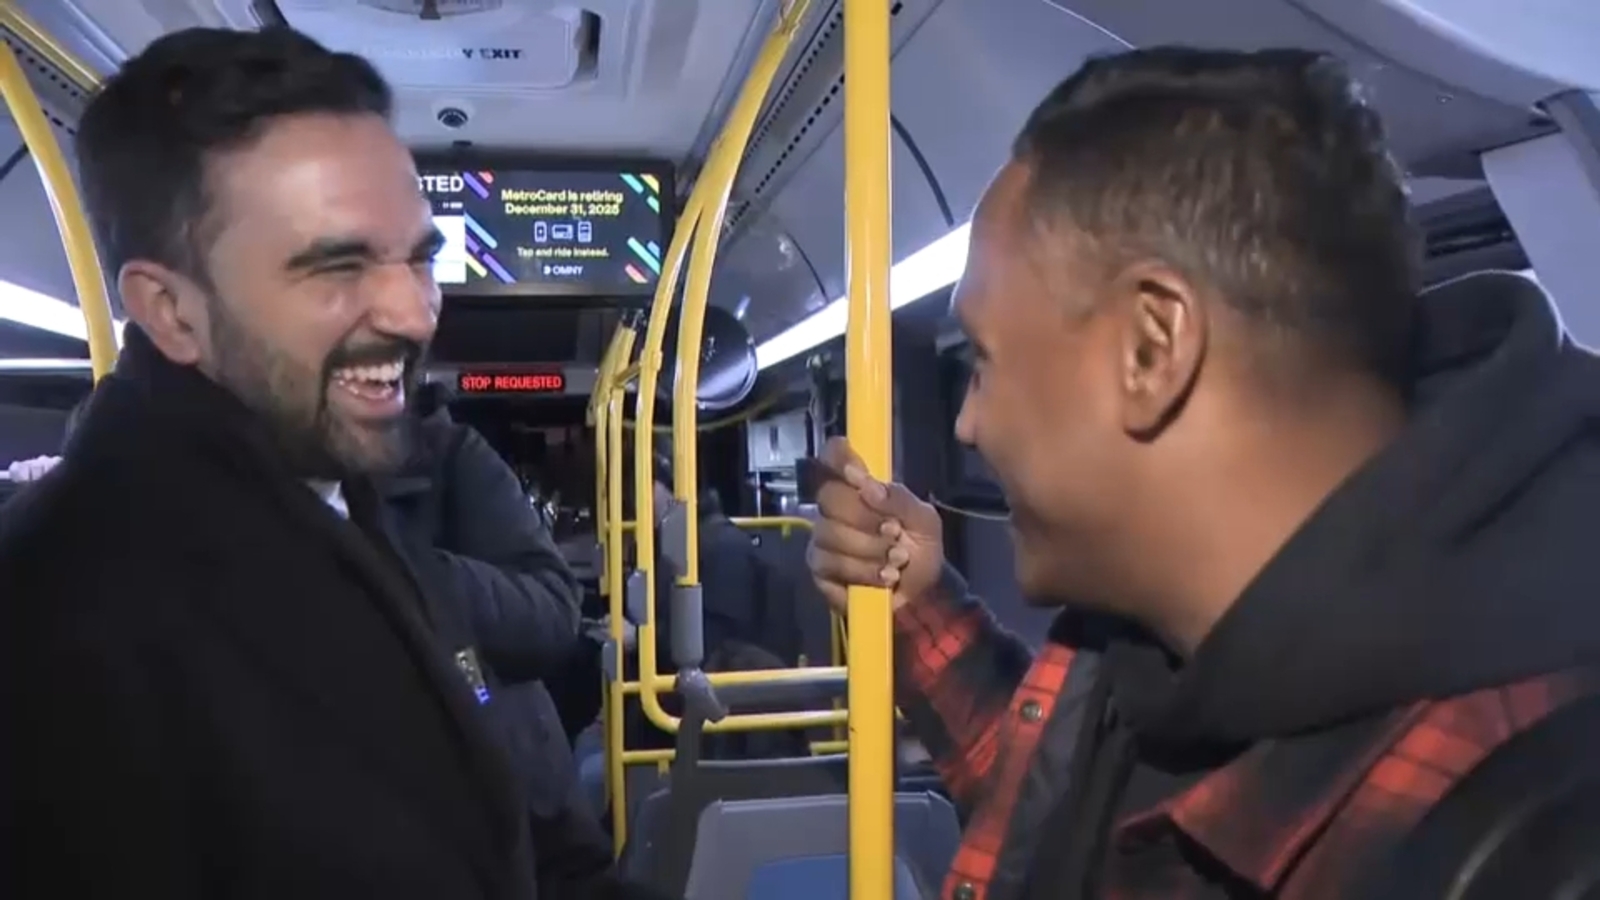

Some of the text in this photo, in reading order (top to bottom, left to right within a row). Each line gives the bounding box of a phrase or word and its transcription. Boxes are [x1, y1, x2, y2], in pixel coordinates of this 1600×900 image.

[480, 49, 522, 59] EXIT
[501, 189, 624, 204] MetroCard is retiring
[505, 202, 620, 216] December 31, 2025
[517, 246, 534, 259] Tap
[535, 246, 553, 257] and
[554, 246, 572, 257] ride
[552, 265, 583, 275] OMNY
[461, 376, 562, 390] STOP REQUESTED
